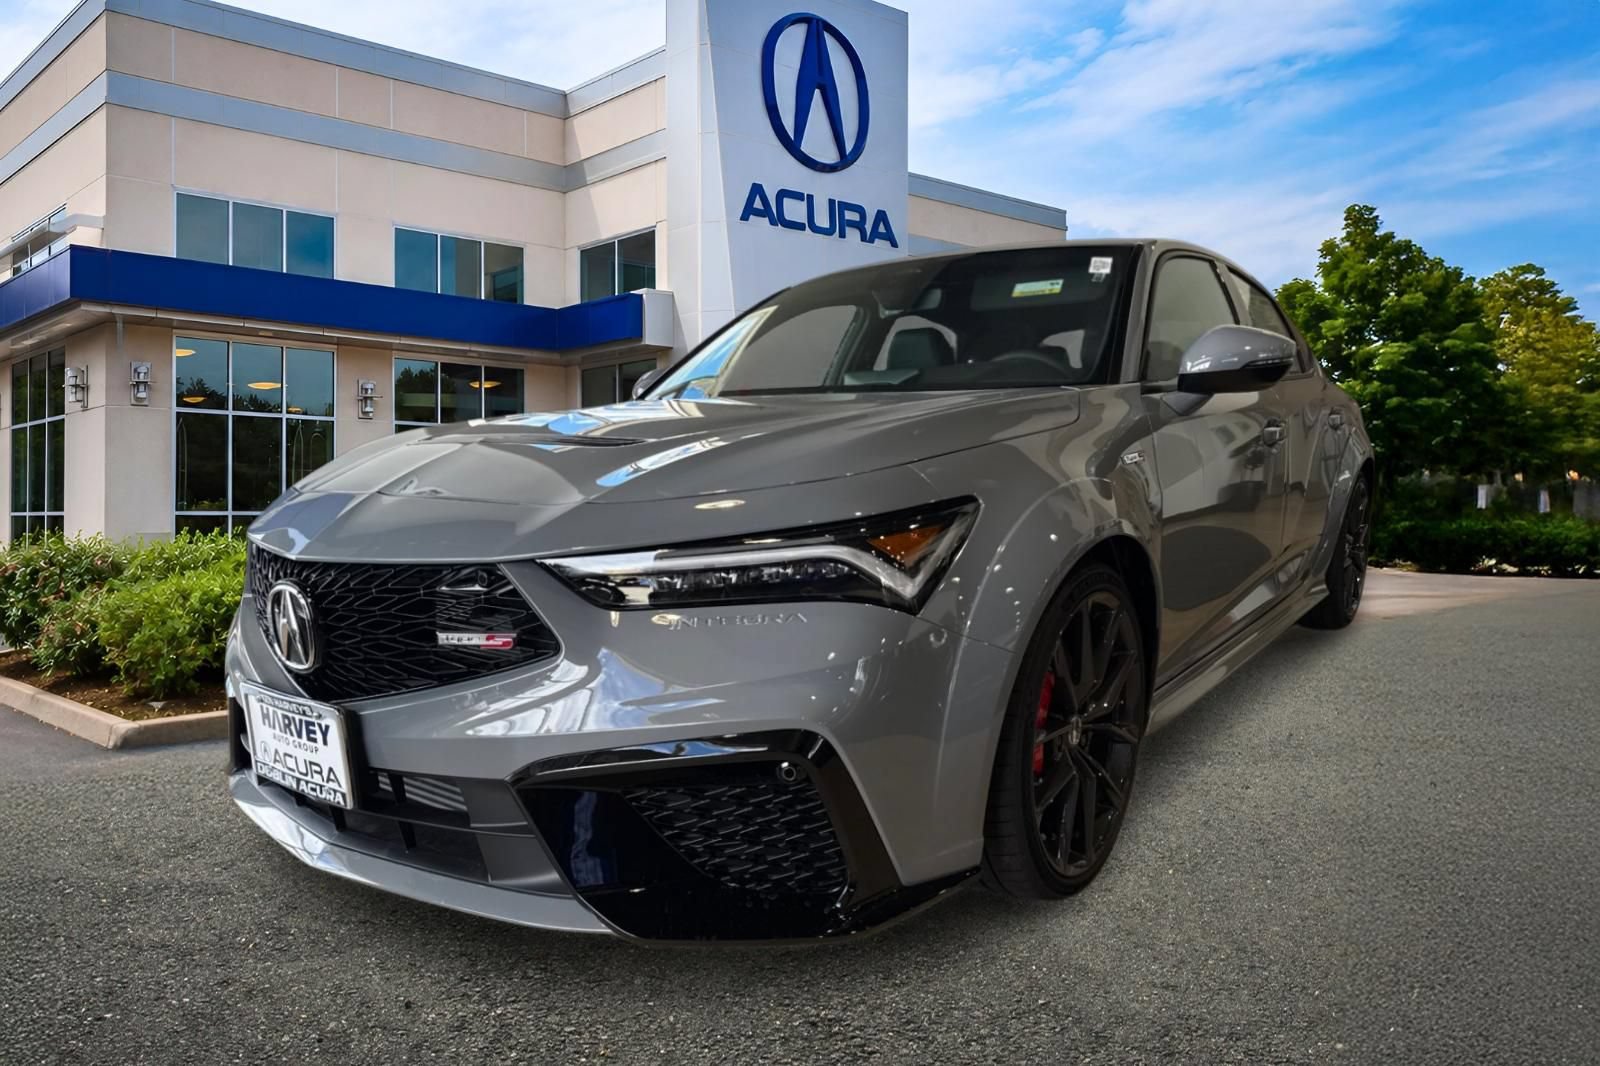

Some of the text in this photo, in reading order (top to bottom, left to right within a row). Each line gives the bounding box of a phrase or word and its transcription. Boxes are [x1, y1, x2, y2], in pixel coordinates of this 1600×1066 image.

[739, 182, 899, 249] ACURA
[260, 705, 330, 747] HARVEY
[273, 733, 319, 754] AUTO GROUP
[273, 749, 343, 788] ACURA
[300, 780, 345, 806] ACURA
